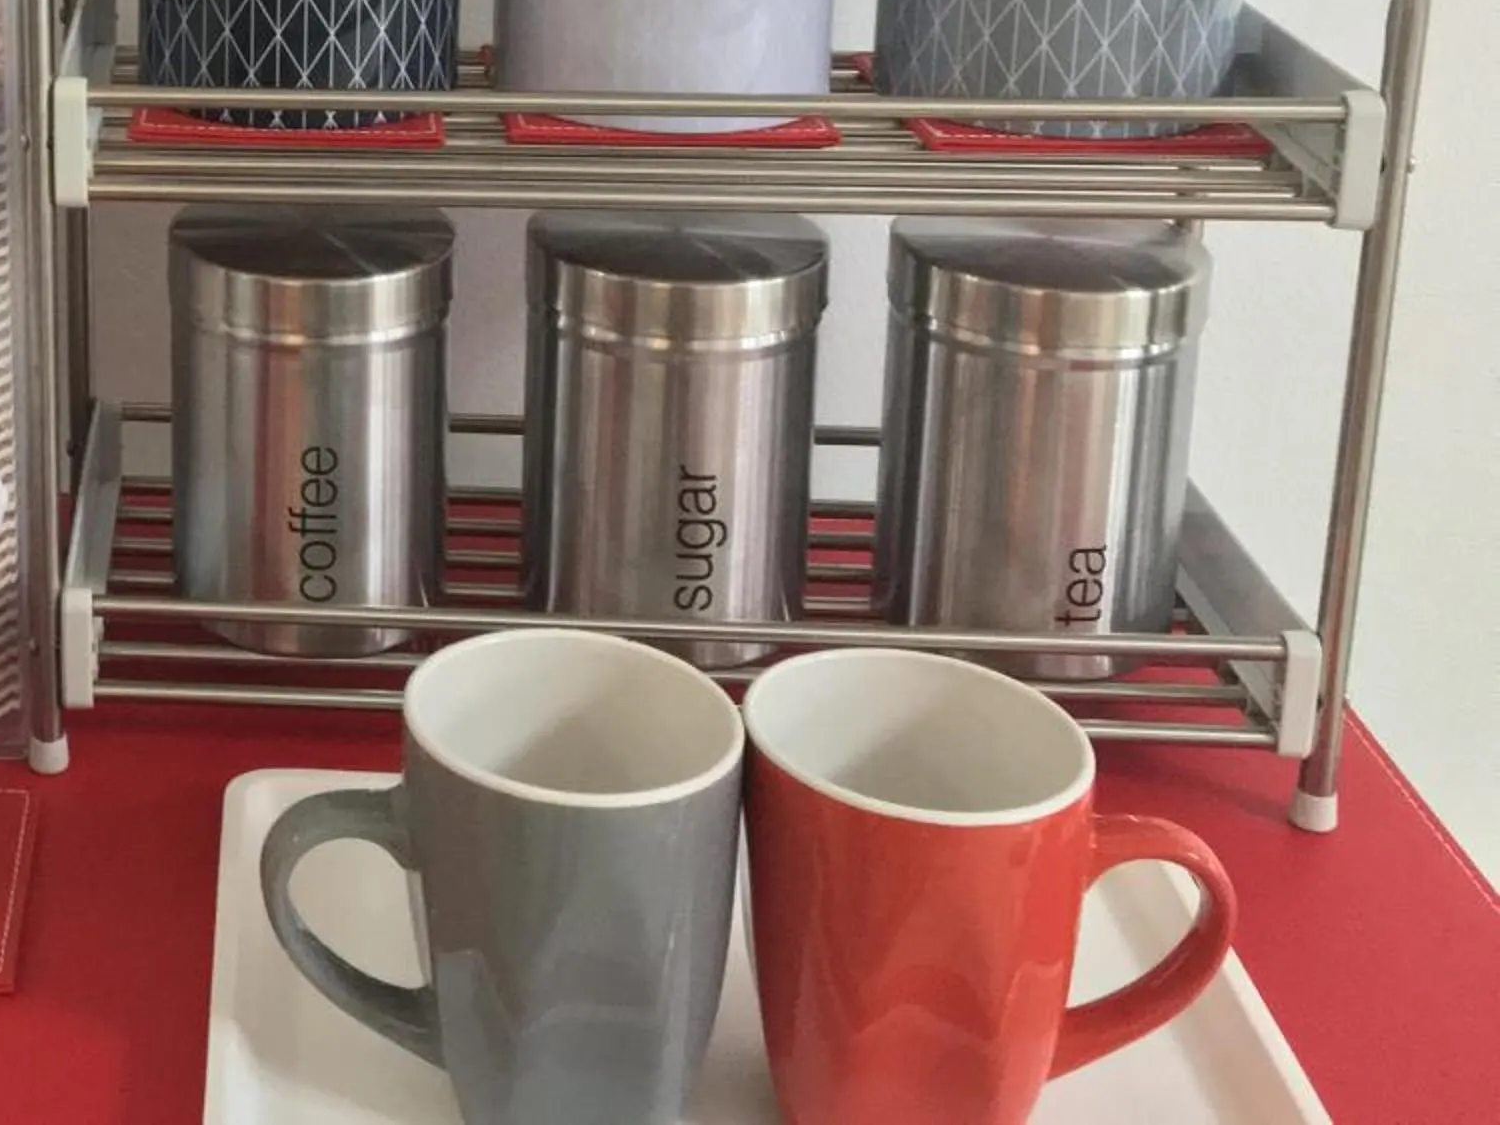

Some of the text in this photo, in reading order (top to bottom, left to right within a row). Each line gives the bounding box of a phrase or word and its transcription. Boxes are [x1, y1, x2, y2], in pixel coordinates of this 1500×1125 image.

[288, 446, 338, 602] coffee
[673, 463, 727, 611] sugar
[1054, 544, 1107, 627] tea
